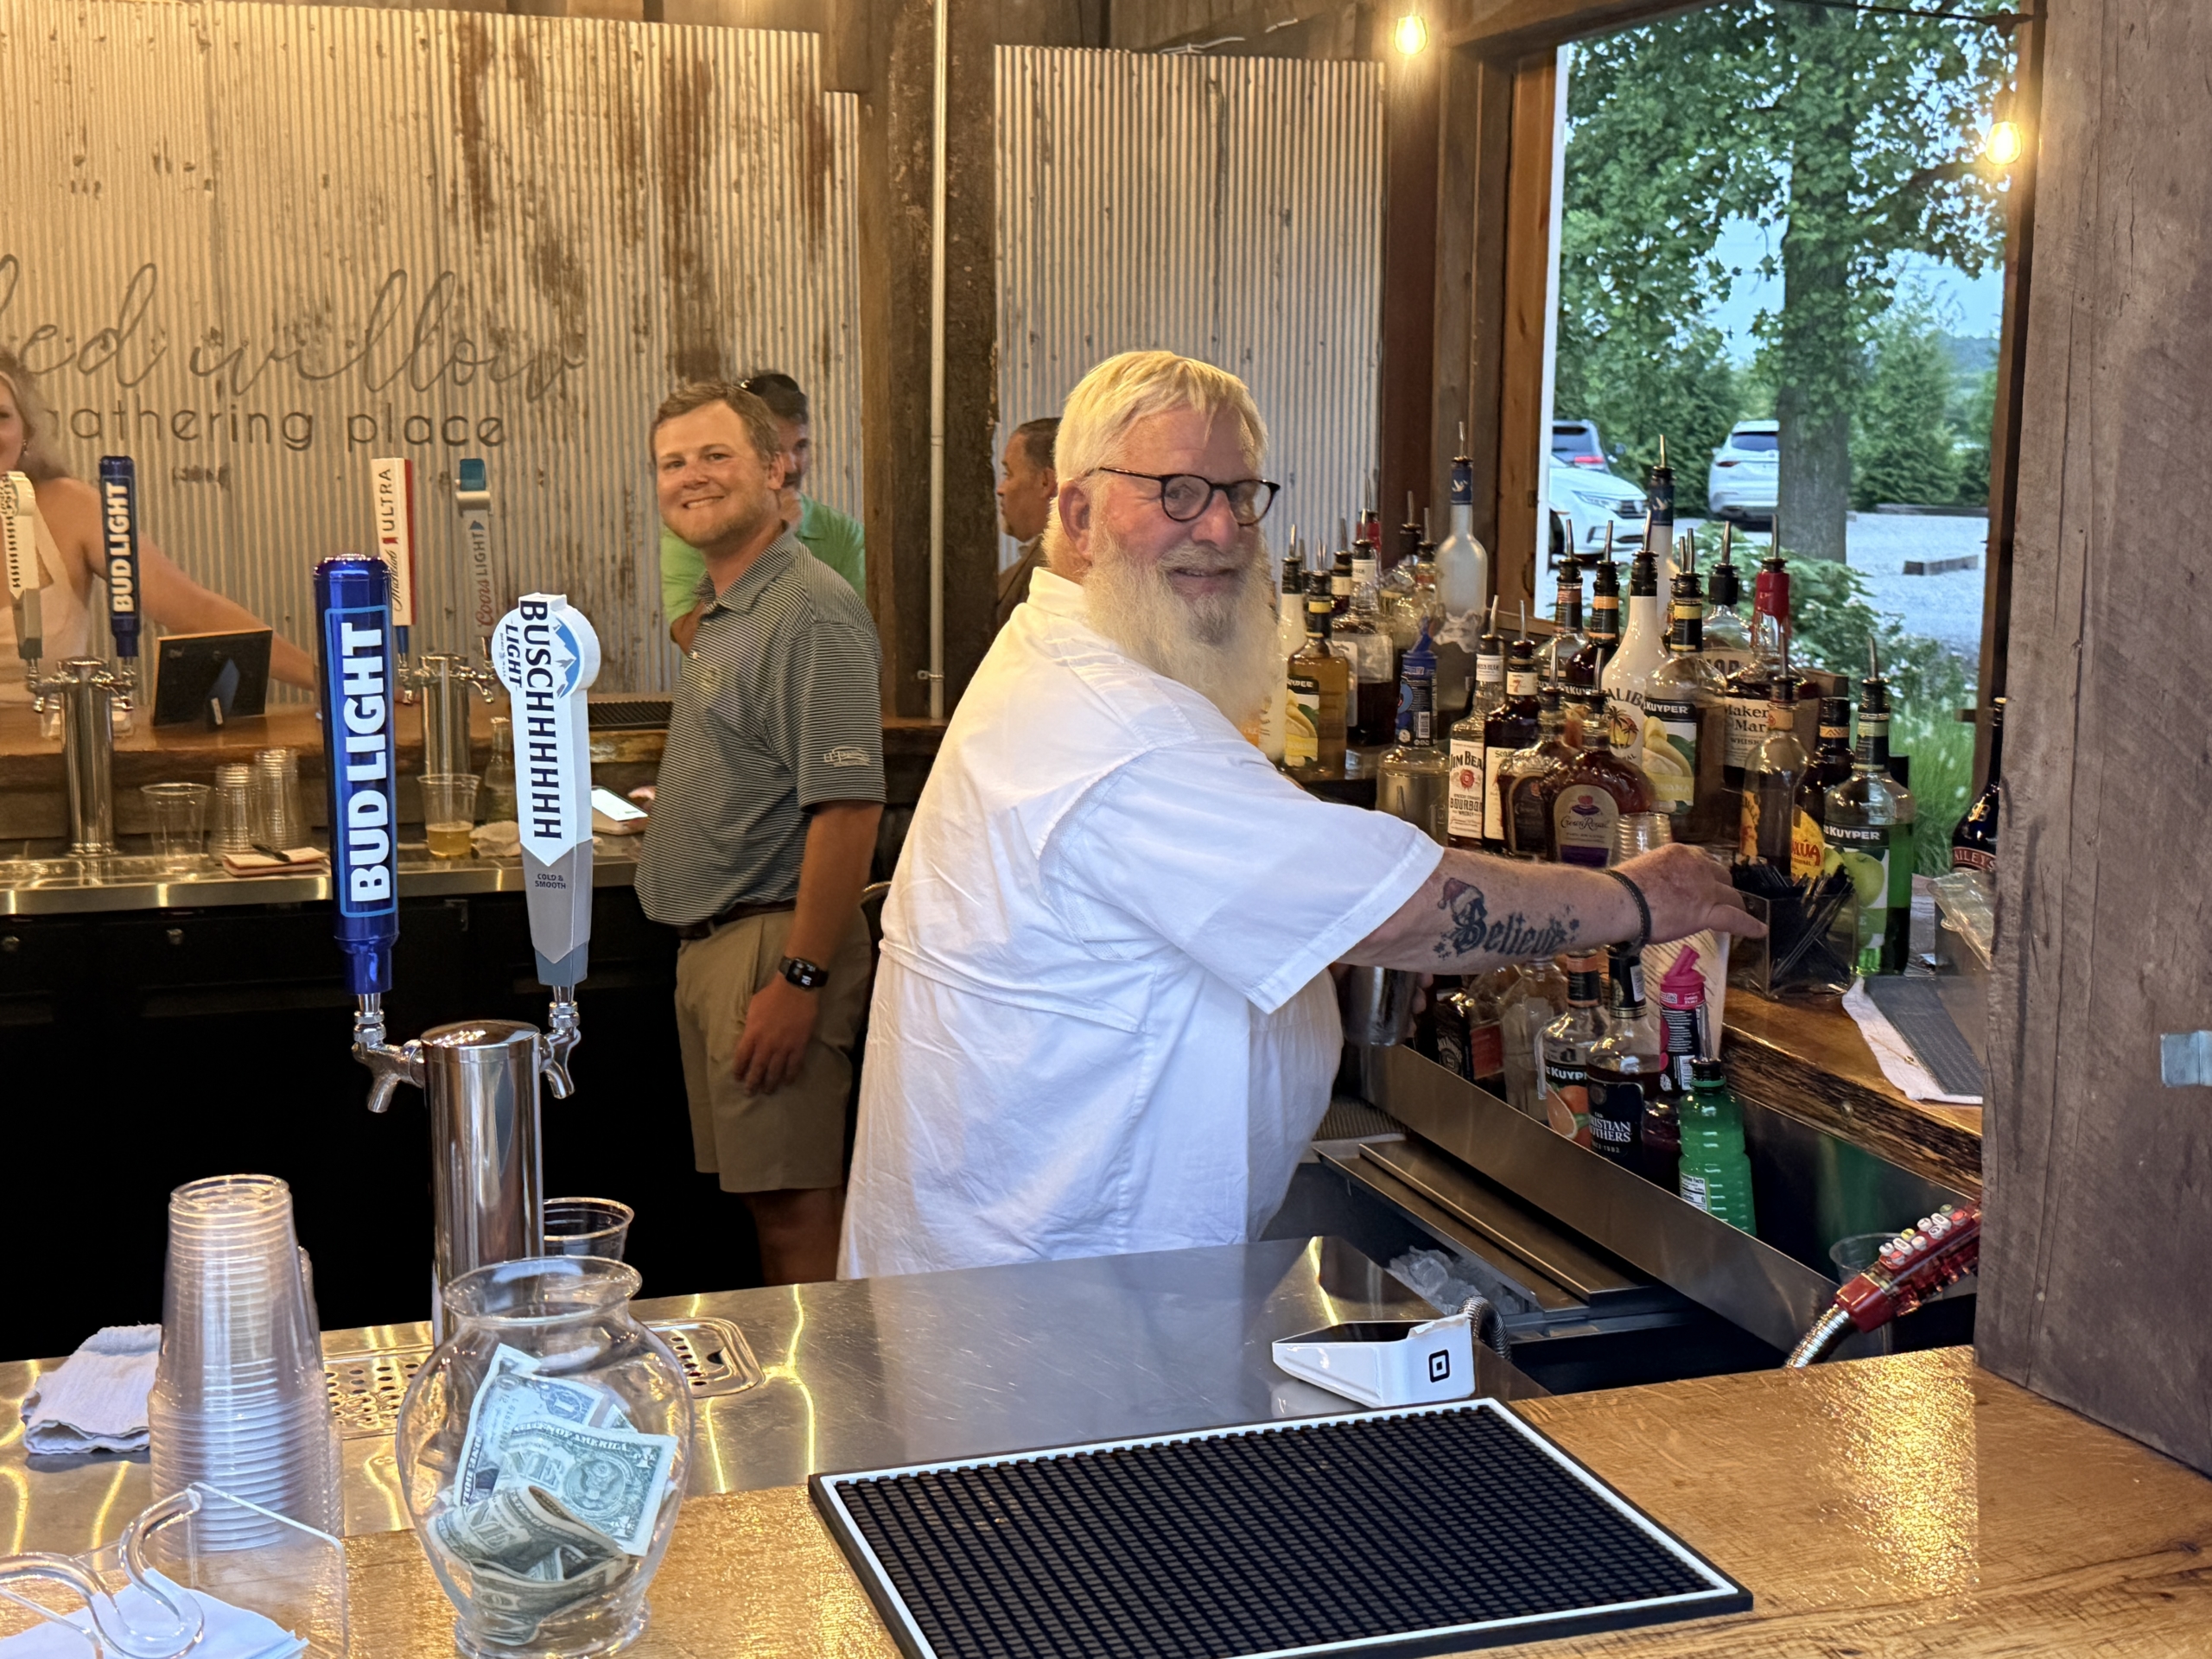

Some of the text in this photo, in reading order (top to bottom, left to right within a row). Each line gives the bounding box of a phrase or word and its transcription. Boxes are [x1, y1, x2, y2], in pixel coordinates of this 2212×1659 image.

[347, 402, 506, 452] place
[378, 467, 397, 532] ULTRA
[105, 481, 135, 613] BUD LIGHT
[473, 532, 495, 628] Coors LIGHT
[505, 624, 523, 689] LIGHT
[1606, 688, 1645, 710] ALIB
[1643, 701, 1689, 715] KUYPER
[519, 600, 563, 841] BUSCHHHHHH
[1734, 719, 1767, 734] Mar
[340, 621, 391, 903] BUD LIGHT
[1451, 750, 1483, 771] JIM BEA
[1560, 815, 1611, 831] Crown Royal
[1954, 849, 1995, 869] AILEYS
[535, 880, 567, 890] SMOOTH
[537, 873, 556, 881] COLD
[1591, 1116, 1631, 1133] RISTIAN
[1591, 1126, 1632, 1143] OTHERS
[574, 1433, 631, 1452] AMERICA
